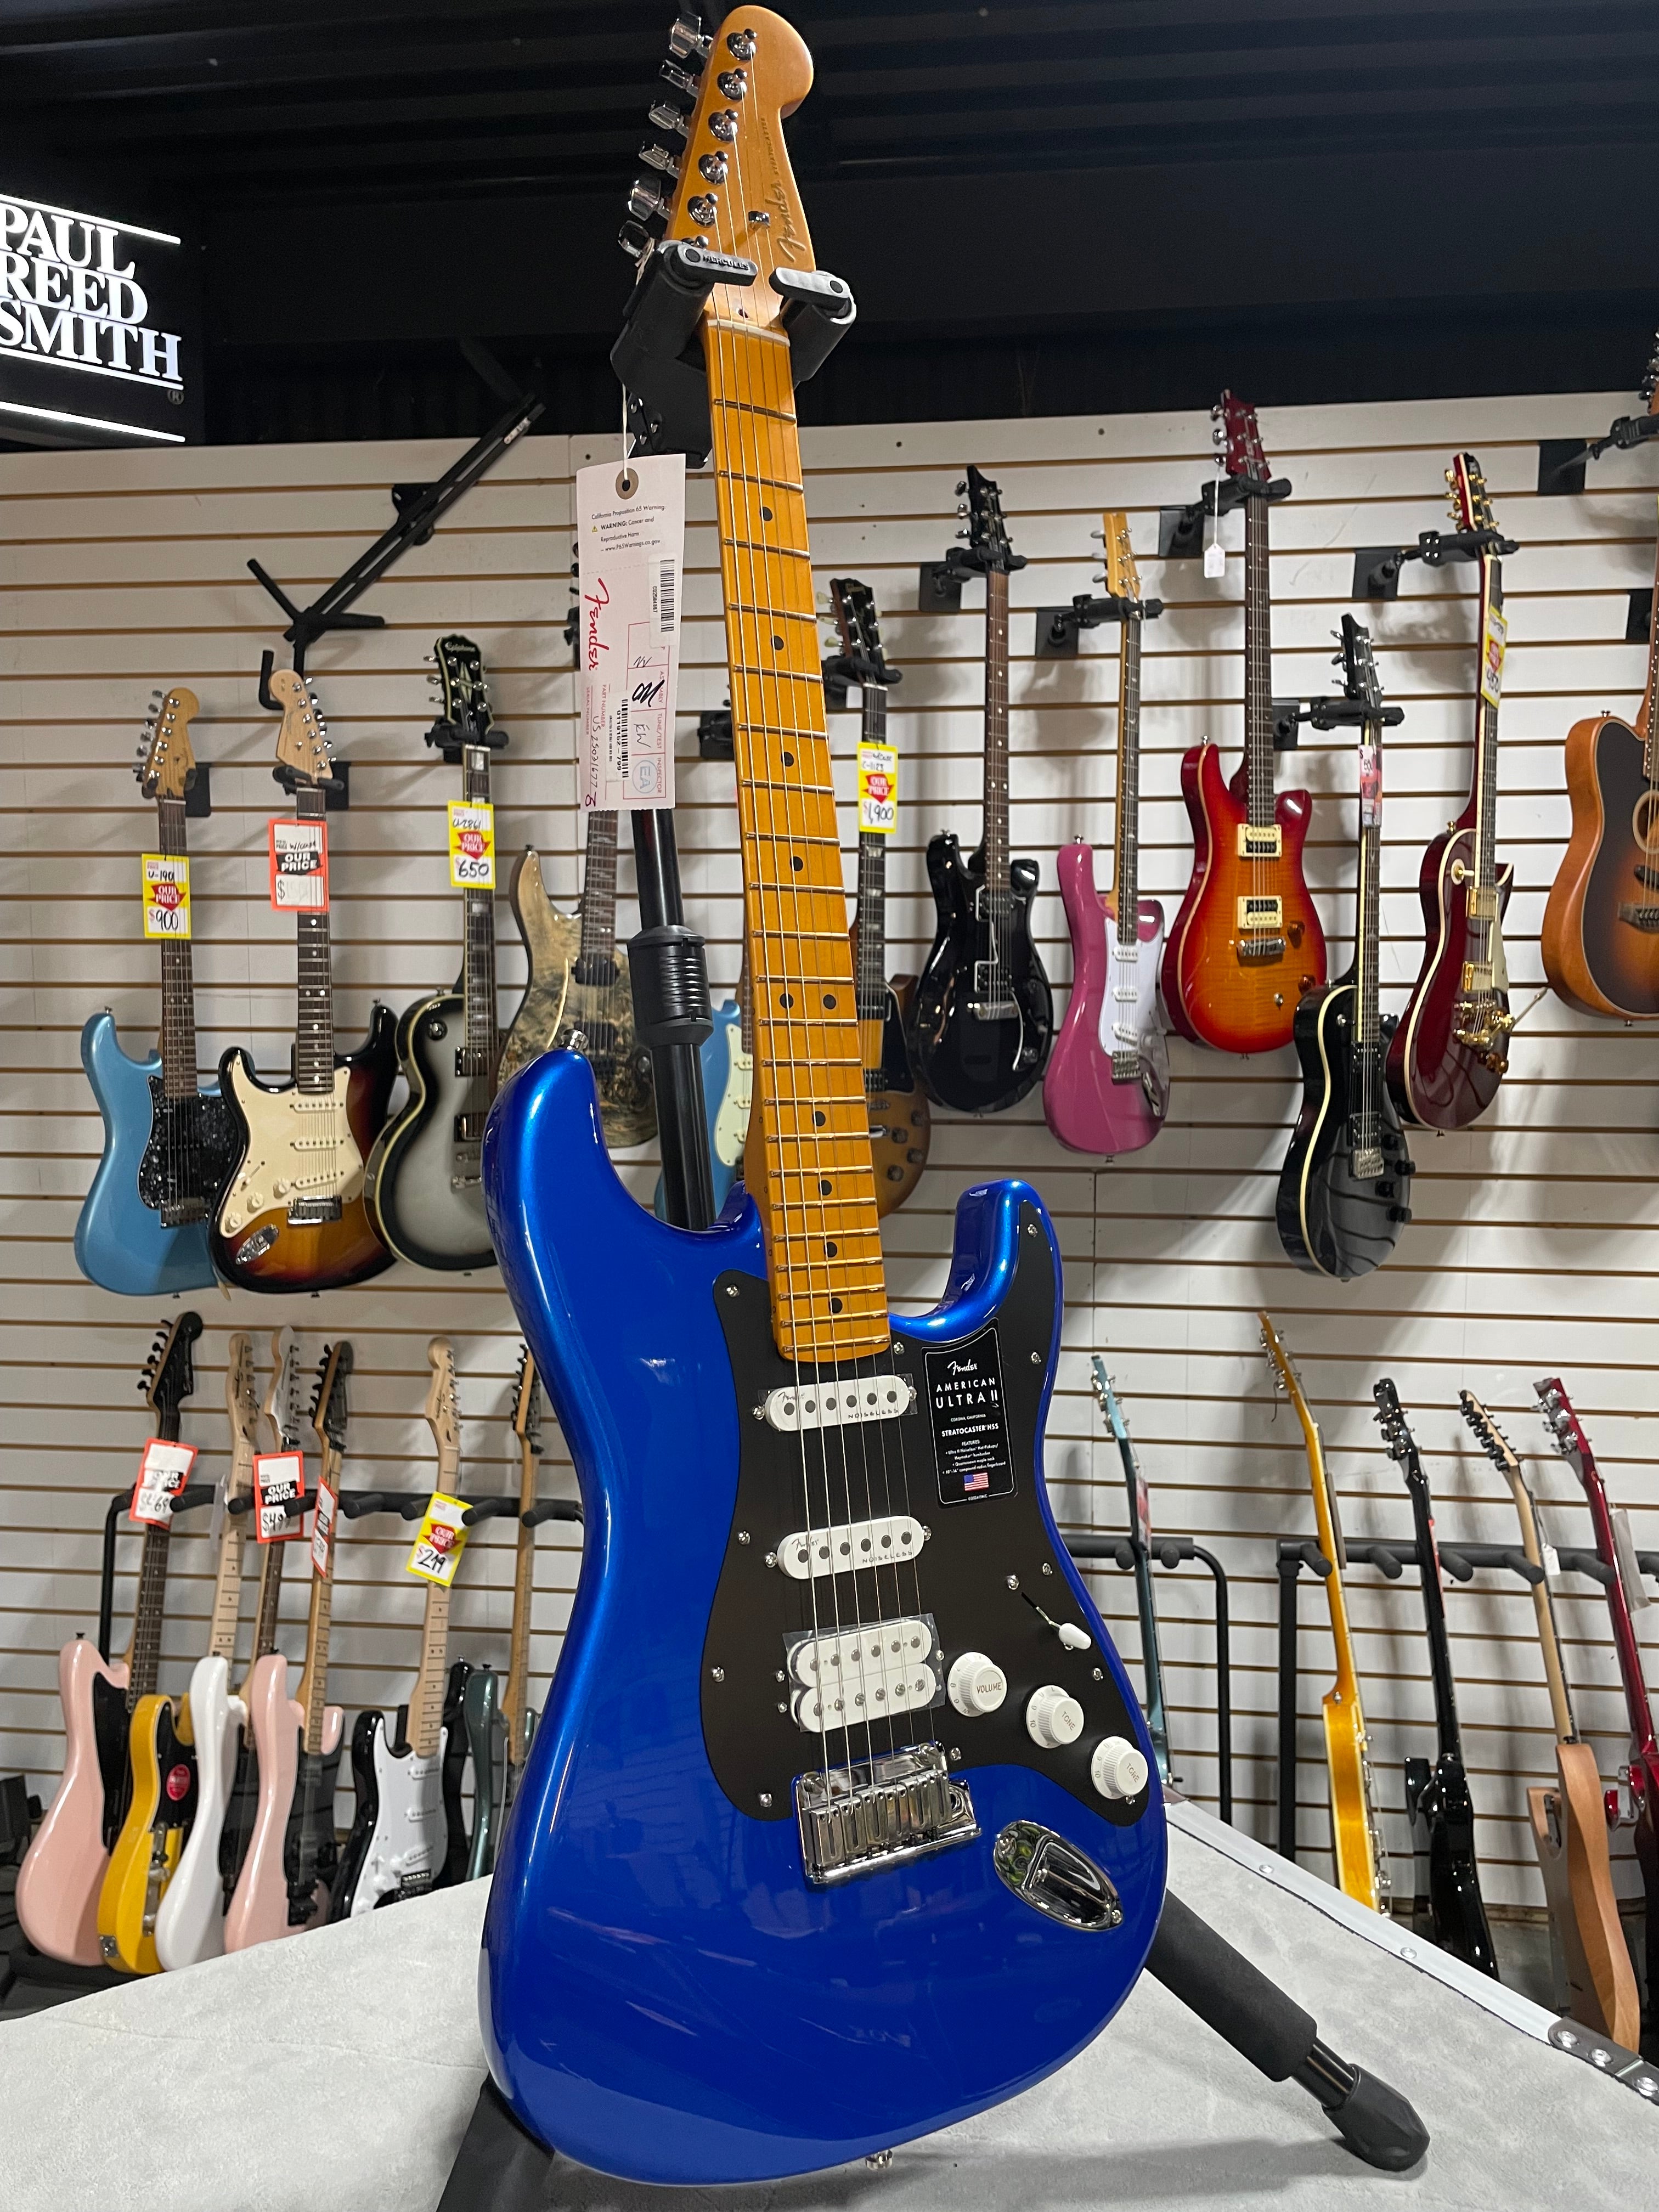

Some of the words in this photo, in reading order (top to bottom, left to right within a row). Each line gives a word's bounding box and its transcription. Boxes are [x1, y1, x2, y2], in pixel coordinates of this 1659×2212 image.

[765, 180, 805, 262] Fender
[0, 204, 136, 280] PAUL
[0, 251, 148, 325] REED
[0, 300, 183, 381] SMITH
[601, 521, 628, 530] WARNING:
[584, 578, 610, 671] Fender
[464, 833, 482, 842] OUR
[461, 842, 486, 853] PRICE
[285, 851, 311, 862] OUR
[281, 860, 318, 872] PRICE
[158, 885, 177, 895] OUR
[155, 894, 180, 904] PRICE
[947, 1359, 978, 1375] Fender
[936, 1377, 996, 1392] AMERICAN
[936, 1393, 986, 1409] ULTRA
[990, 1390, 998, 1401] II
[268, 1482, 291, 1494] OUR
[264, 1489, 296, 1505] PRICE
[977, 1681, 1002, 1694] VOLUME
[1062, 1711, 1076, 1731] TONE
[1126, 1763, 1140, 1783] TONE
